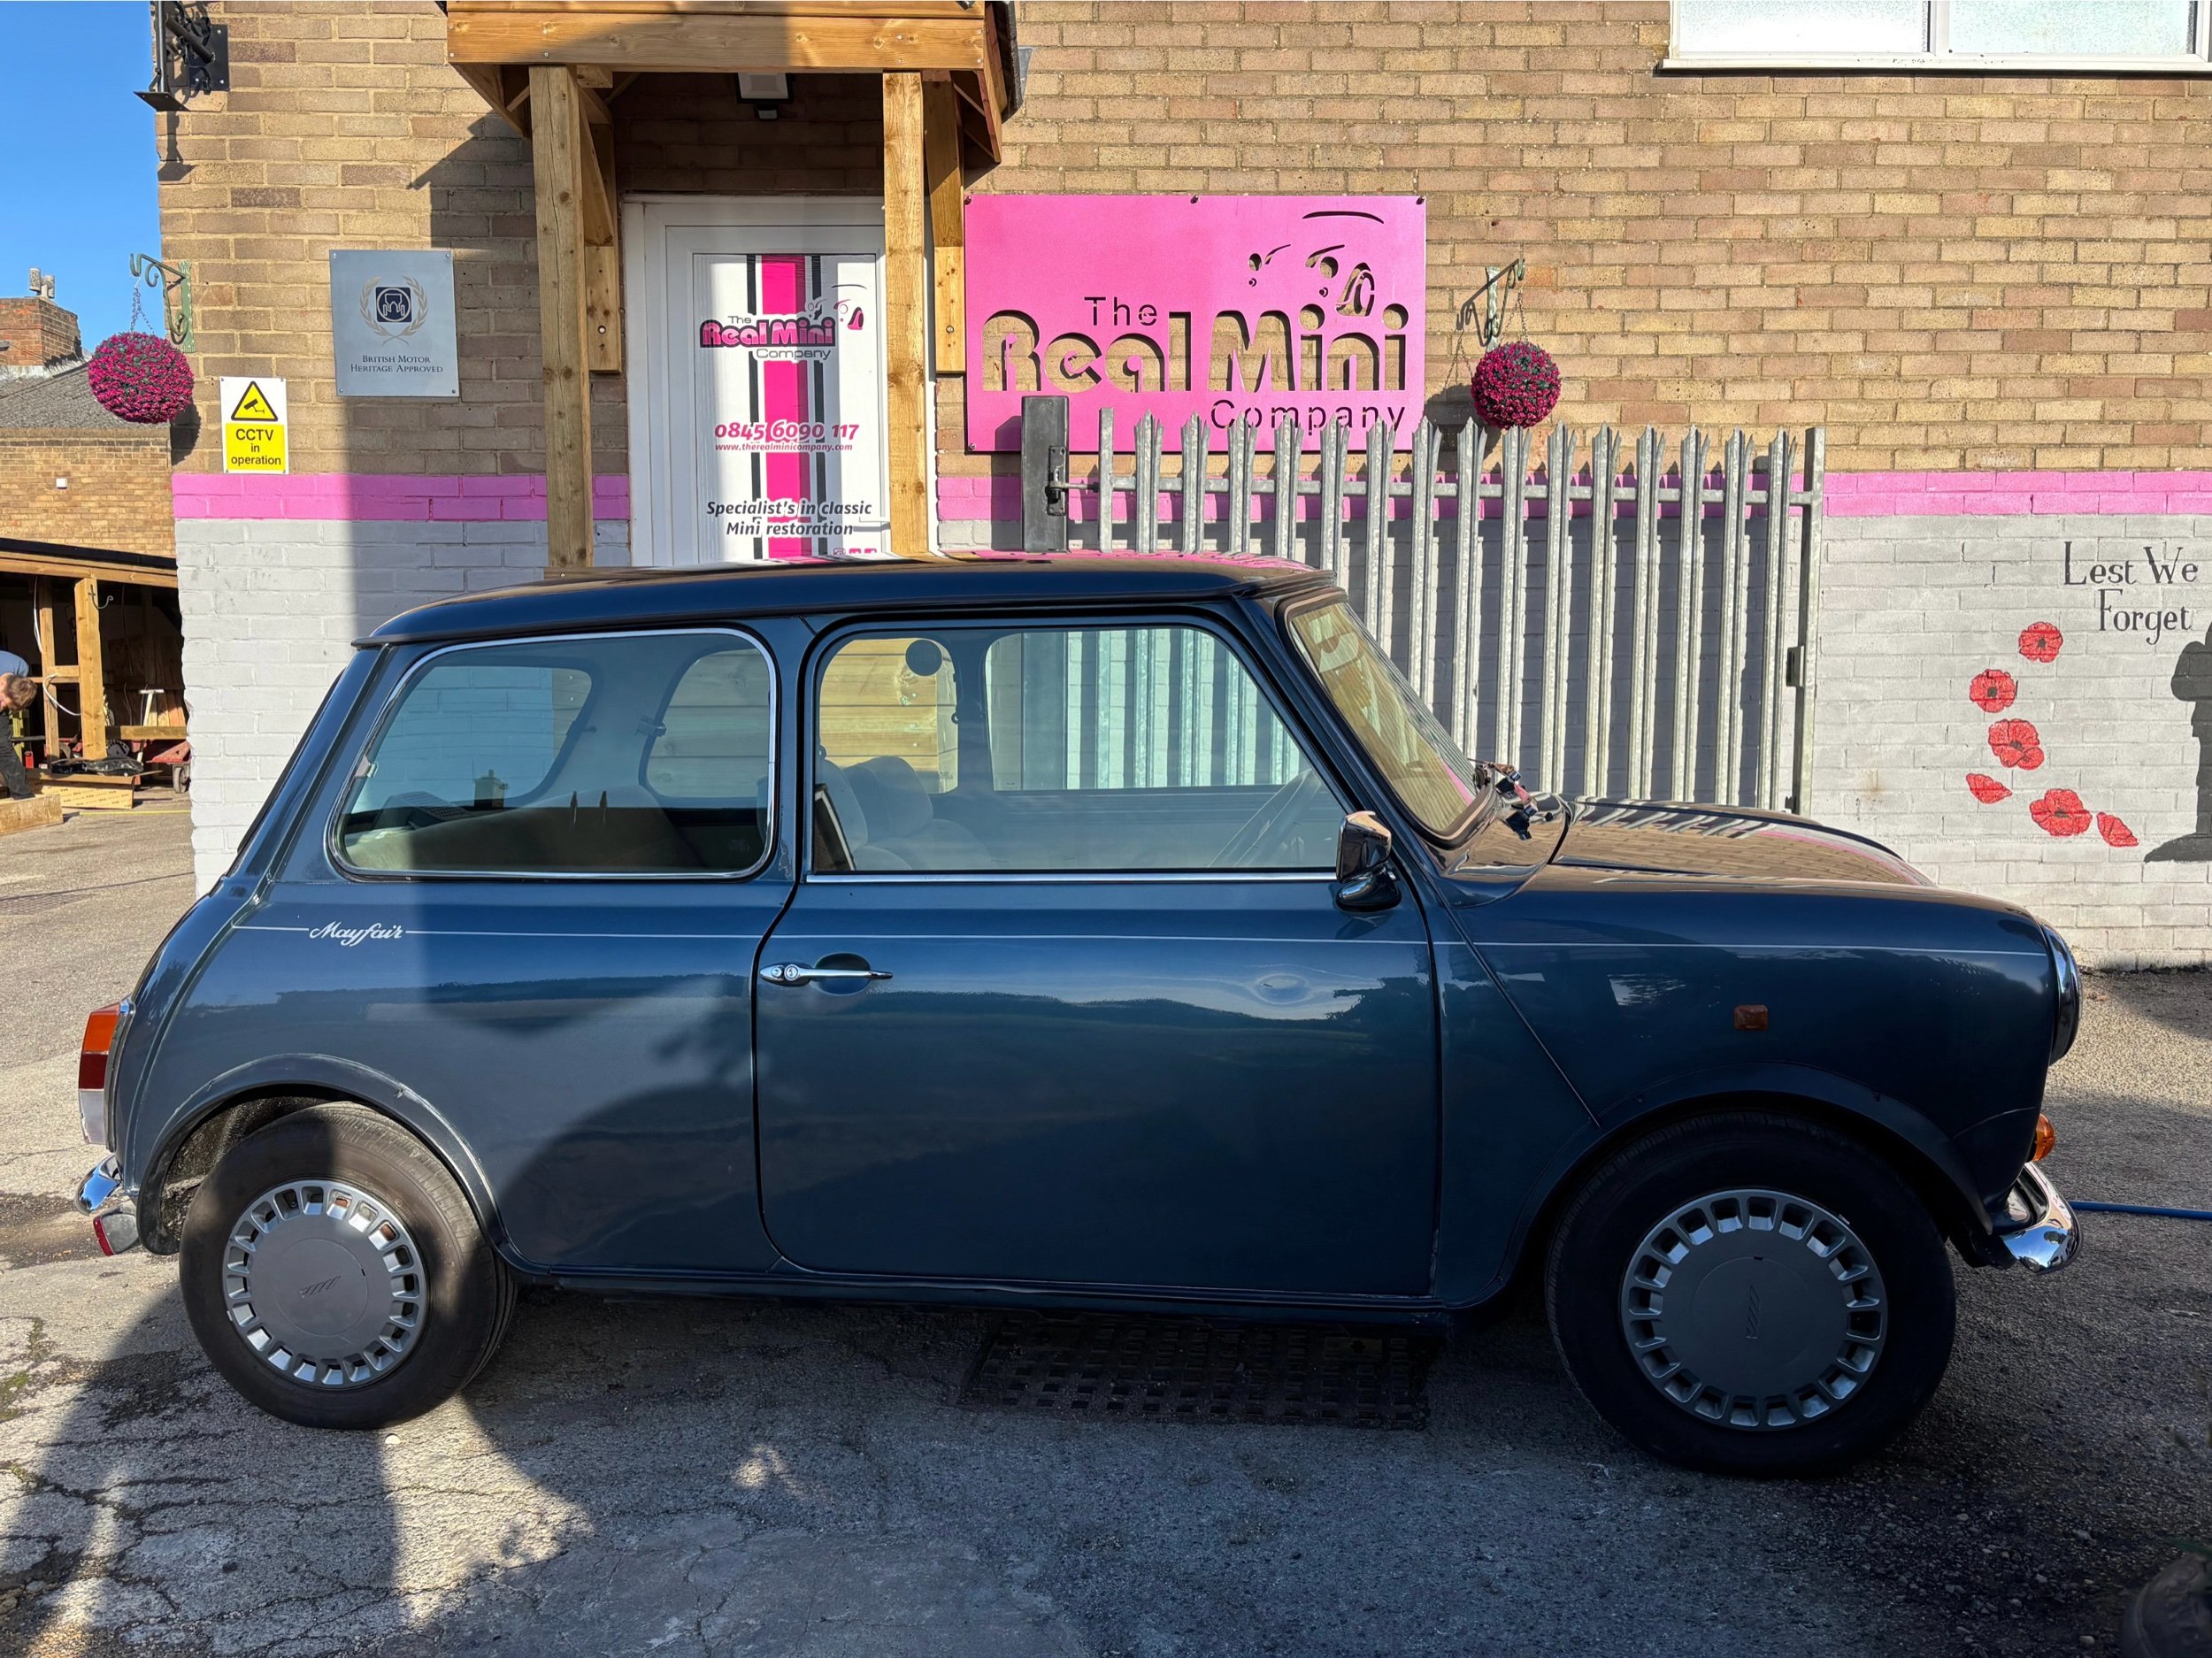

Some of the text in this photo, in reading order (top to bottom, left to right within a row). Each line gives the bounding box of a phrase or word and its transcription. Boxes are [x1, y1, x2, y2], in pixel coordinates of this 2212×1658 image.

[1084, 296, 1156, 326] The
[727, 315, 752, 325] The
[701, 319, 835, 347] Real Mini
[756, 348, 831, 360] Company
[981, 303, 1409, 394] Real Mini
[362, 355, 431, 364] BRITISH MOTOR
[350, 364, 443, 372] HERITAGE APPROVED
[1210, 398, 1406, 436] Company
[235, 428, 274, 441] CCTV
[714, 419, 860, 441] 0845 6090 117
[250, 442, 260, 453] in
[715, 442, 853, 452] www.therealminicompany.com
[231, 455, 281, 466] operation
[706, 500, 872, 517] Specialist's in classic
[726, 520, 854, 536] Mini restoration
[2063, 541, 2200, 586] Lest We
[2097, 587, 2193, 646] Forget
[309, 920, 403, 948] Mayfair
